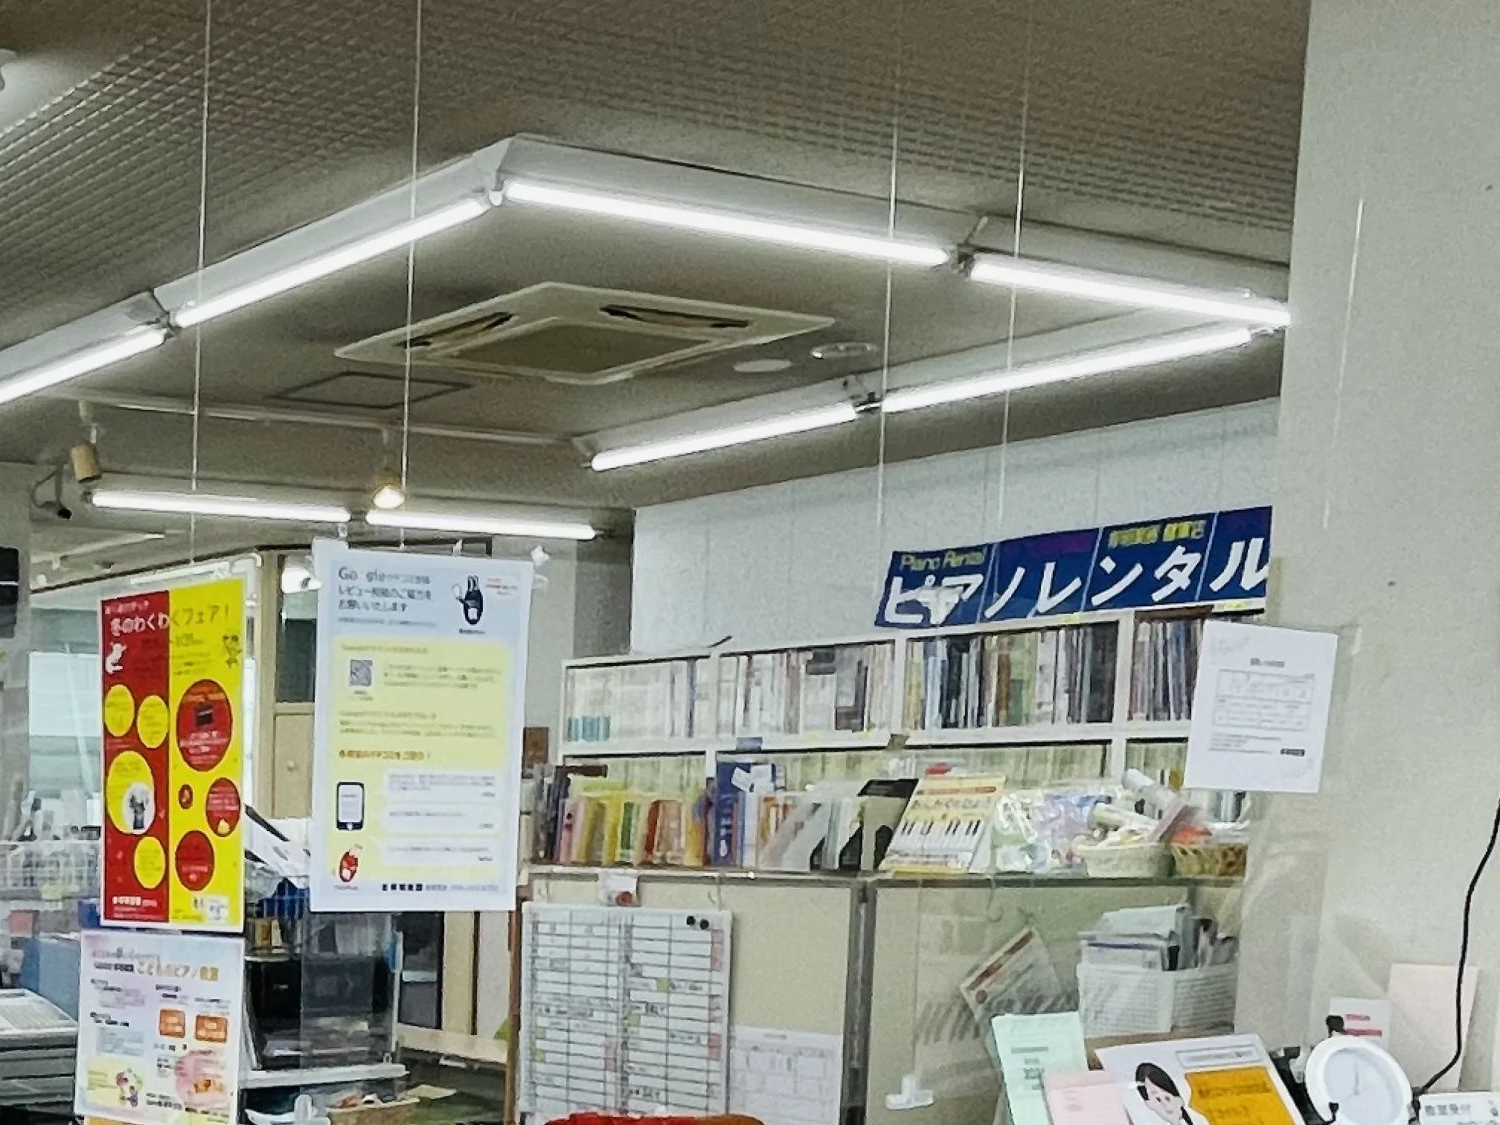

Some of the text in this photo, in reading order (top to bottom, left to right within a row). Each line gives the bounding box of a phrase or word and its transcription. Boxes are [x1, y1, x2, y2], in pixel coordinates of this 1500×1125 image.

[885, 537, 1268, 624] ピアノレンタル
